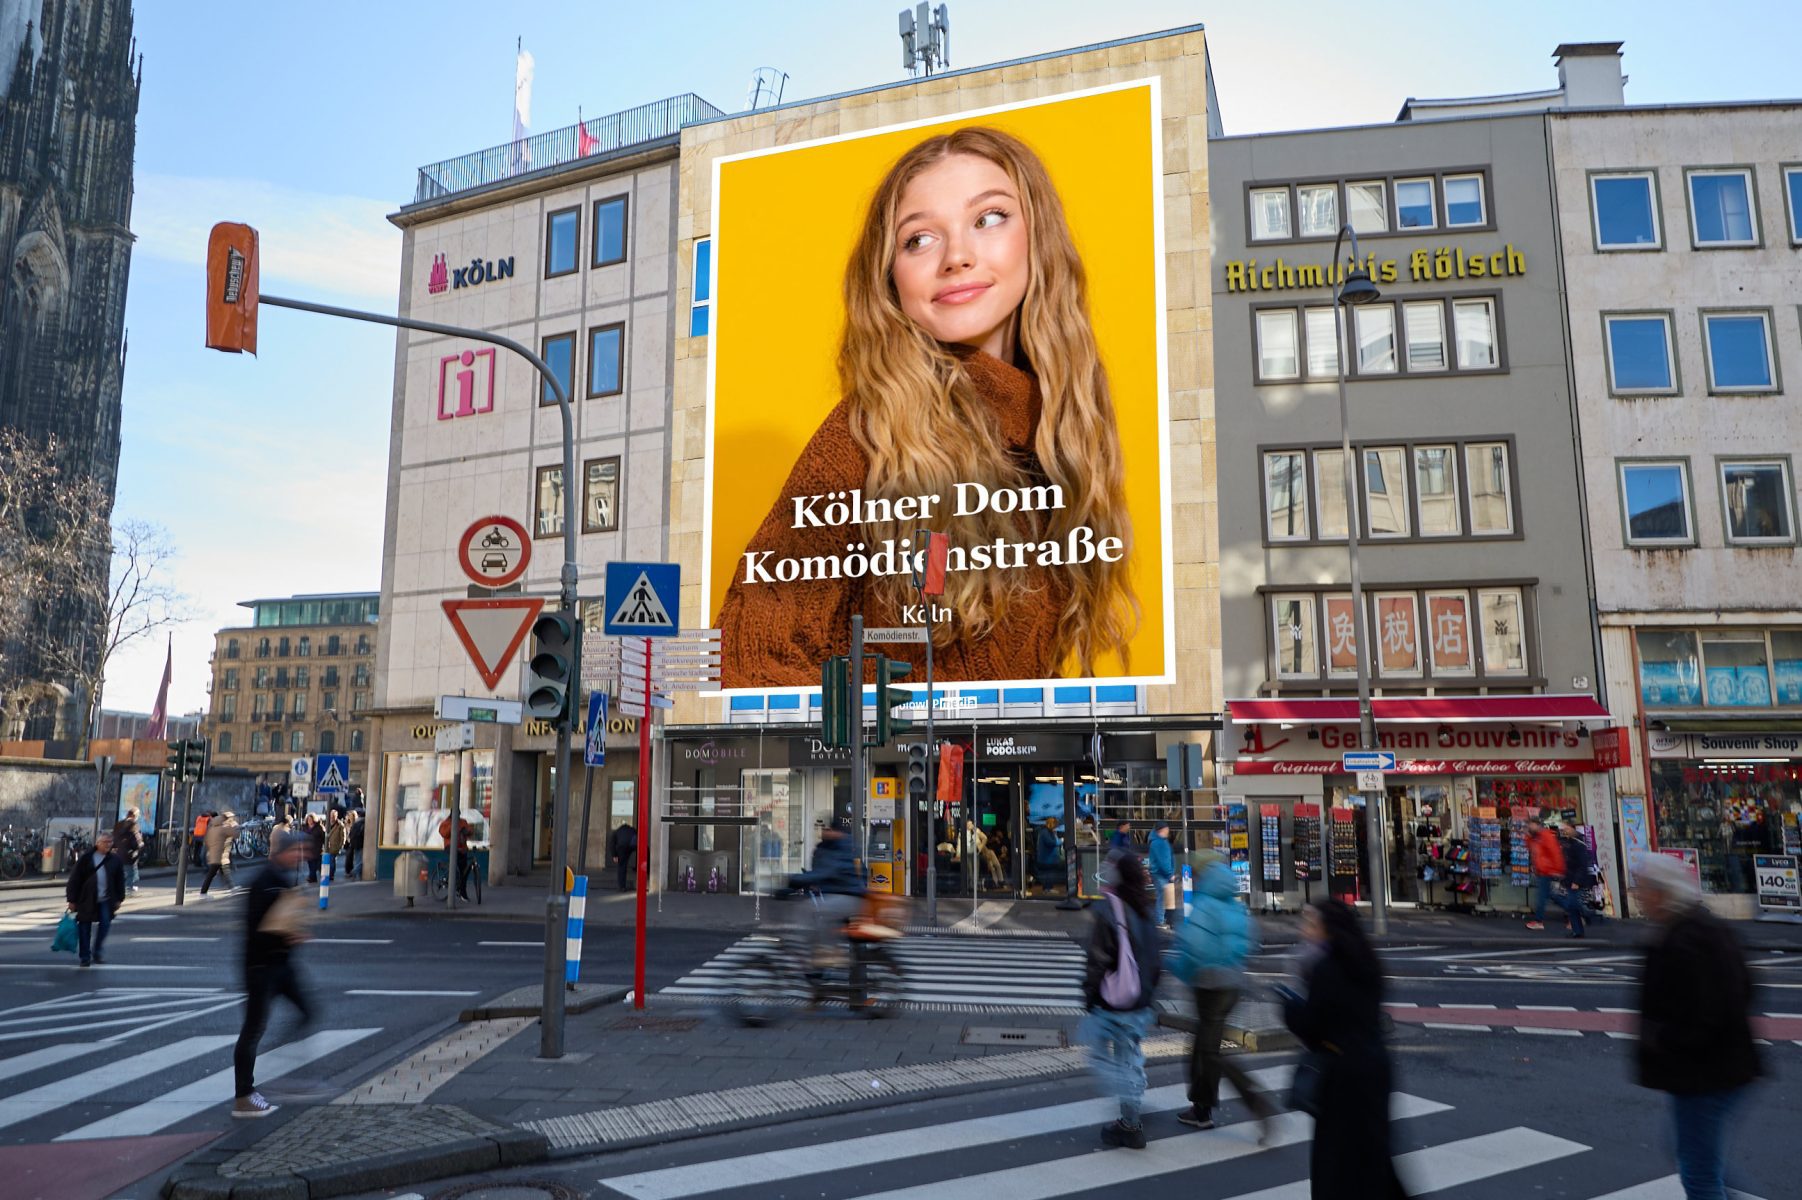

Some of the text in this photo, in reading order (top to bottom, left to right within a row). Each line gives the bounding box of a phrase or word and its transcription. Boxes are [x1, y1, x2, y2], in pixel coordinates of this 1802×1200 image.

[1410, 243, 1526, 281] Kölsch
[452, 256, 515, 290] KÖLN
[791, 482, 1066, 529] Kölner Dom
[903, 604, 952, 624] Köln
[867, 630, 920, 641] Komödienstr.
[525, 718, 636, 736] INFION
[986, 737, 1014, 747] LUKAS
[1321, 725, 1430, 749] Geman
[1701, 735, 1799, 751] Souvenir Shop
[685, 748, 746, 759] DOMOBILE
[1272, 762, 1338, 774] Original
[1453, 760, 1511, 772] Cuckoo
[1514, 760, 1566, 772] Clocks
[1492, 778, 1564, 793] GERMAN
[1760, 875, 1785, 888] 140
